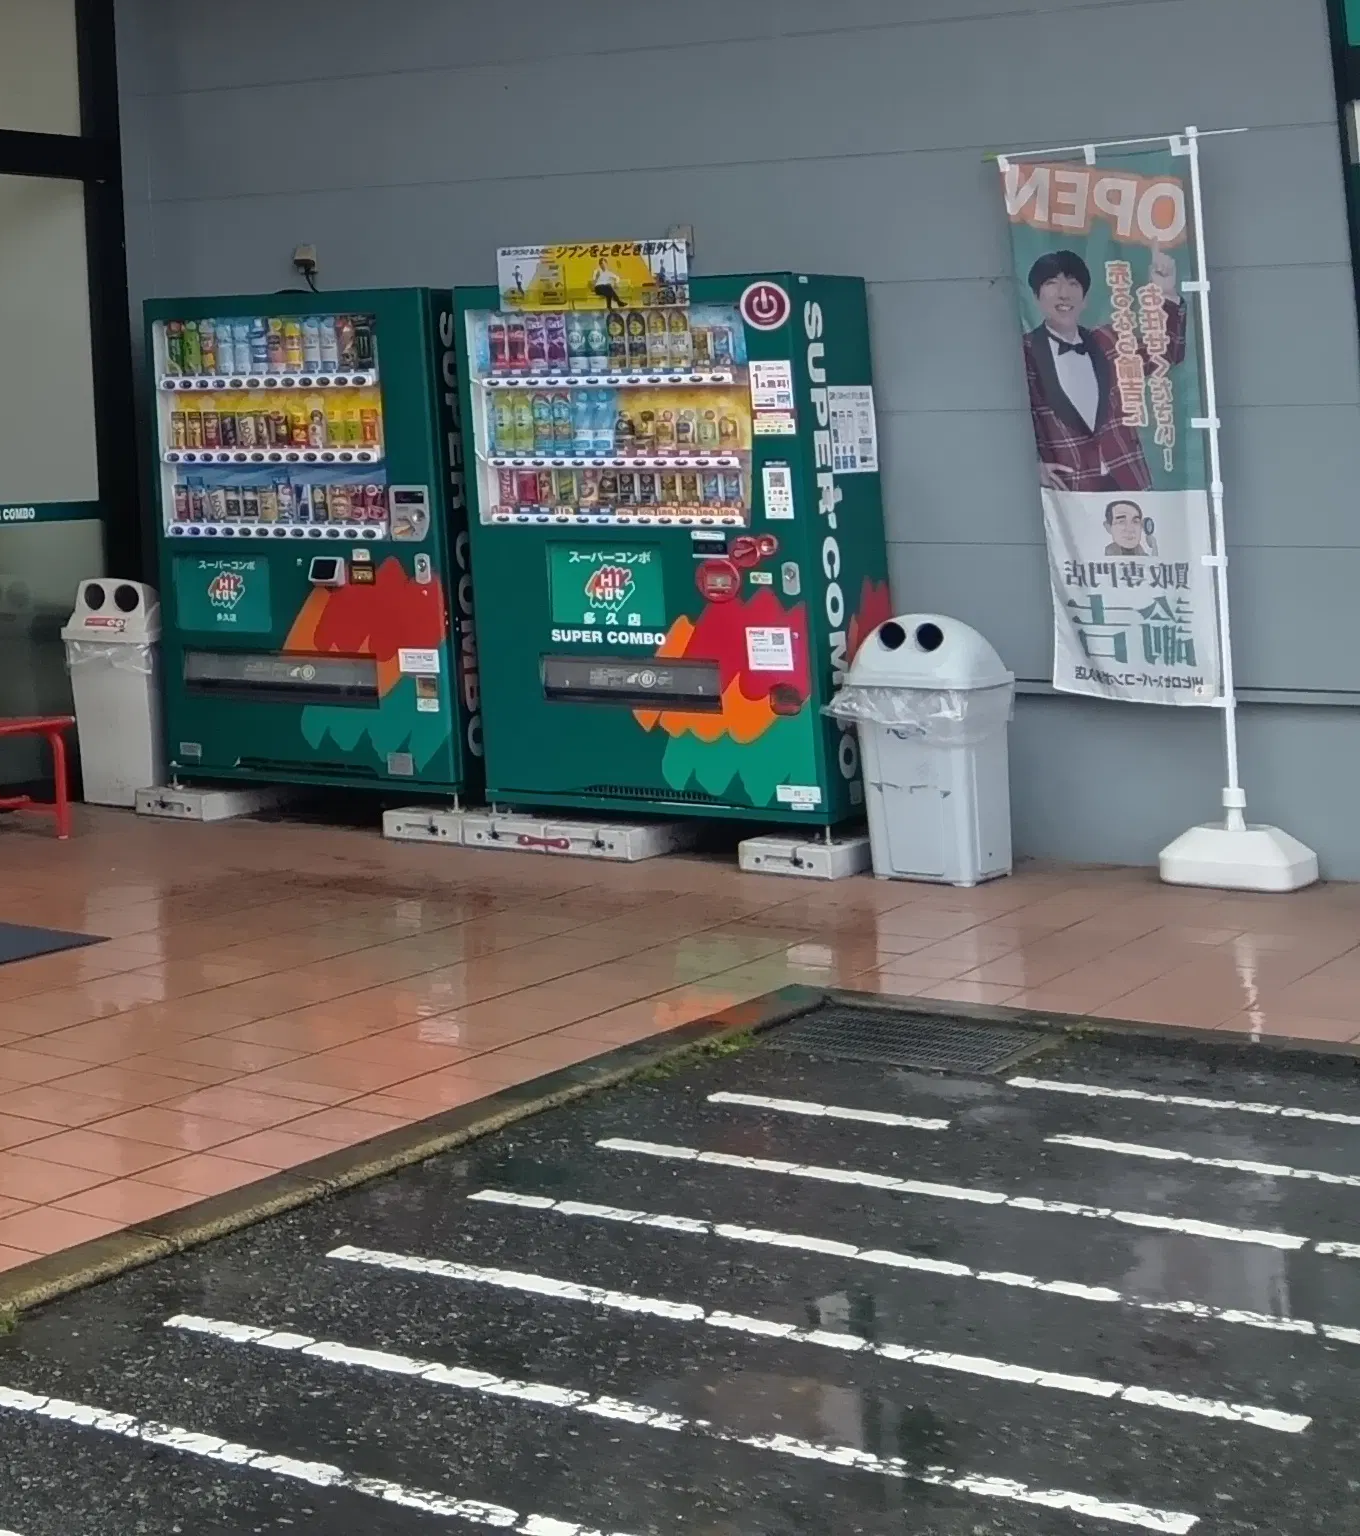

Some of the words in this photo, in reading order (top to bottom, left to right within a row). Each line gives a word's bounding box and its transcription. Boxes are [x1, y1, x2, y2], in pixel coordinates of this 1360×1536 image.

[804, 300, 839, 530] SUPER
[2, 506, 36, 521] COMBO
[440, 311, 466, 512] SUPER
[455, 529, 485, 758] COMBO
[568, 550, 652, 563] スーパーコンボ
[198, 560, 256, 571] スーパーコンボ
[218, 578, 234, 590] HI
[600, 573, 621, 587] HI
[595, 587, 625, 601] ヒロセ
[583, 612, 641, 626] 多久店
[551, 628, 603, 644] SUPER
[607, 629, 667, 646] COMBO
